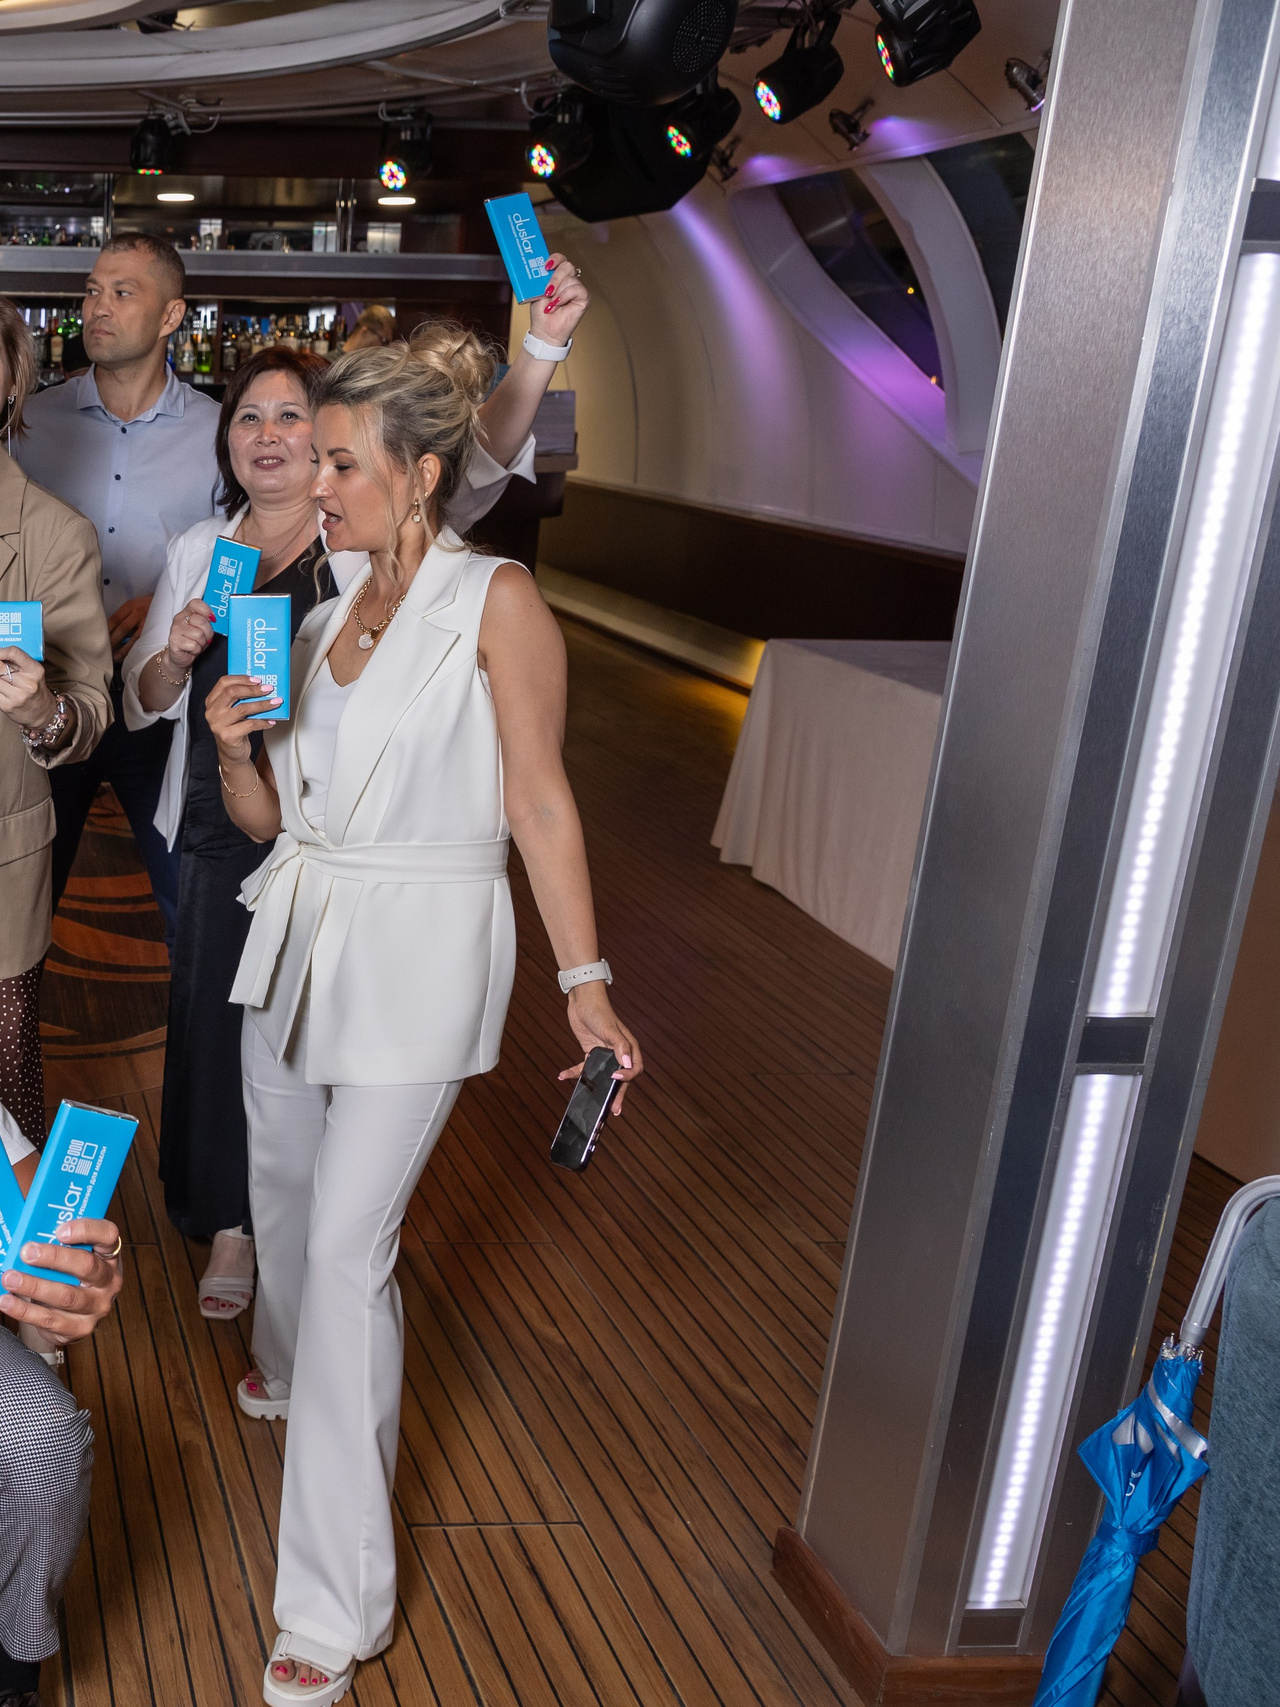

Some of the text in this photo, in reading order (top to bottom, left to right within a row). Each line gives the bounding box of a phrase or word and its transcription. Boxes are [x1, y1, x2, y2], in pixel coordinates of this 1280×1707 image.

[513, 213, 536, 254] duslar
[210, 579, 232, 618] duslar
[254, 618, 278, 669] duslar
[80, 1146, 108, 1216] РЕШЕНИЙ ДЛЯ МЕБЕЛИ
[36, 1181, 83, 1244] slar
